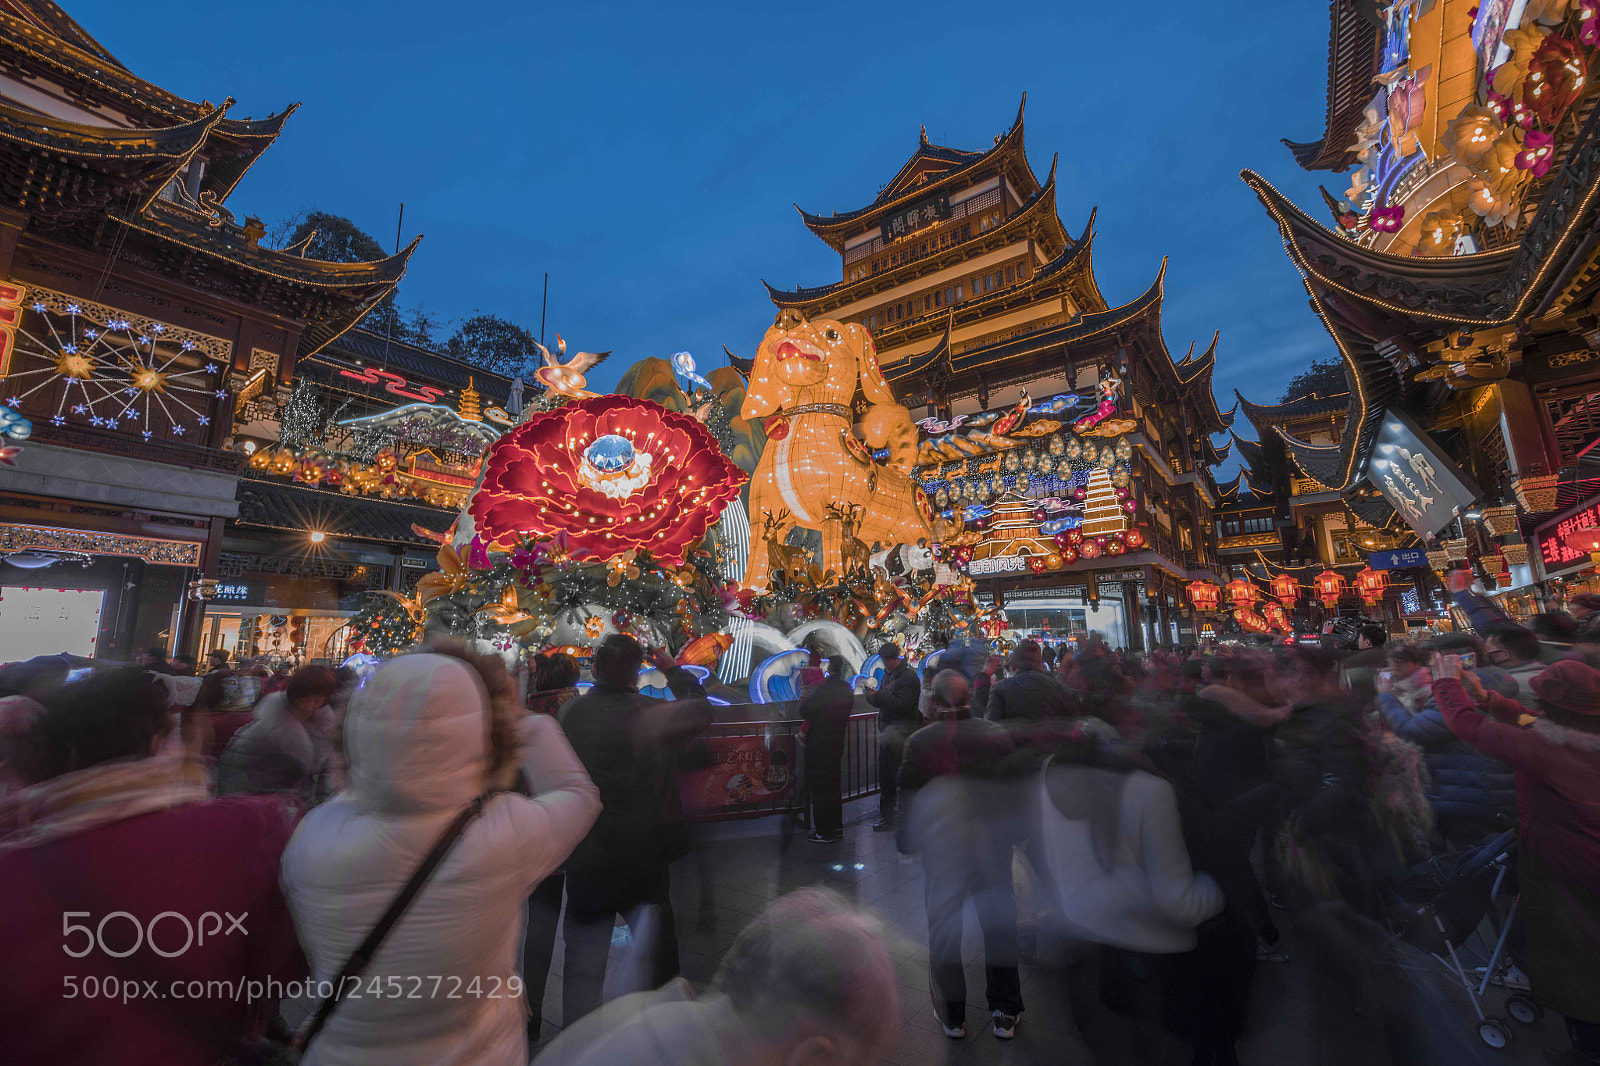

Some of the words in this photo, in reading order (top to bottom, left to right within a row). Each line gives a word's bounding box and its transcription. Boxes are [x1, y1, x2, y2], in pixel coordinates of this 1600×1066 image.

[1401, 551, 1419, 560] 出口
[969, 556, 1026, 574] 西部风光
